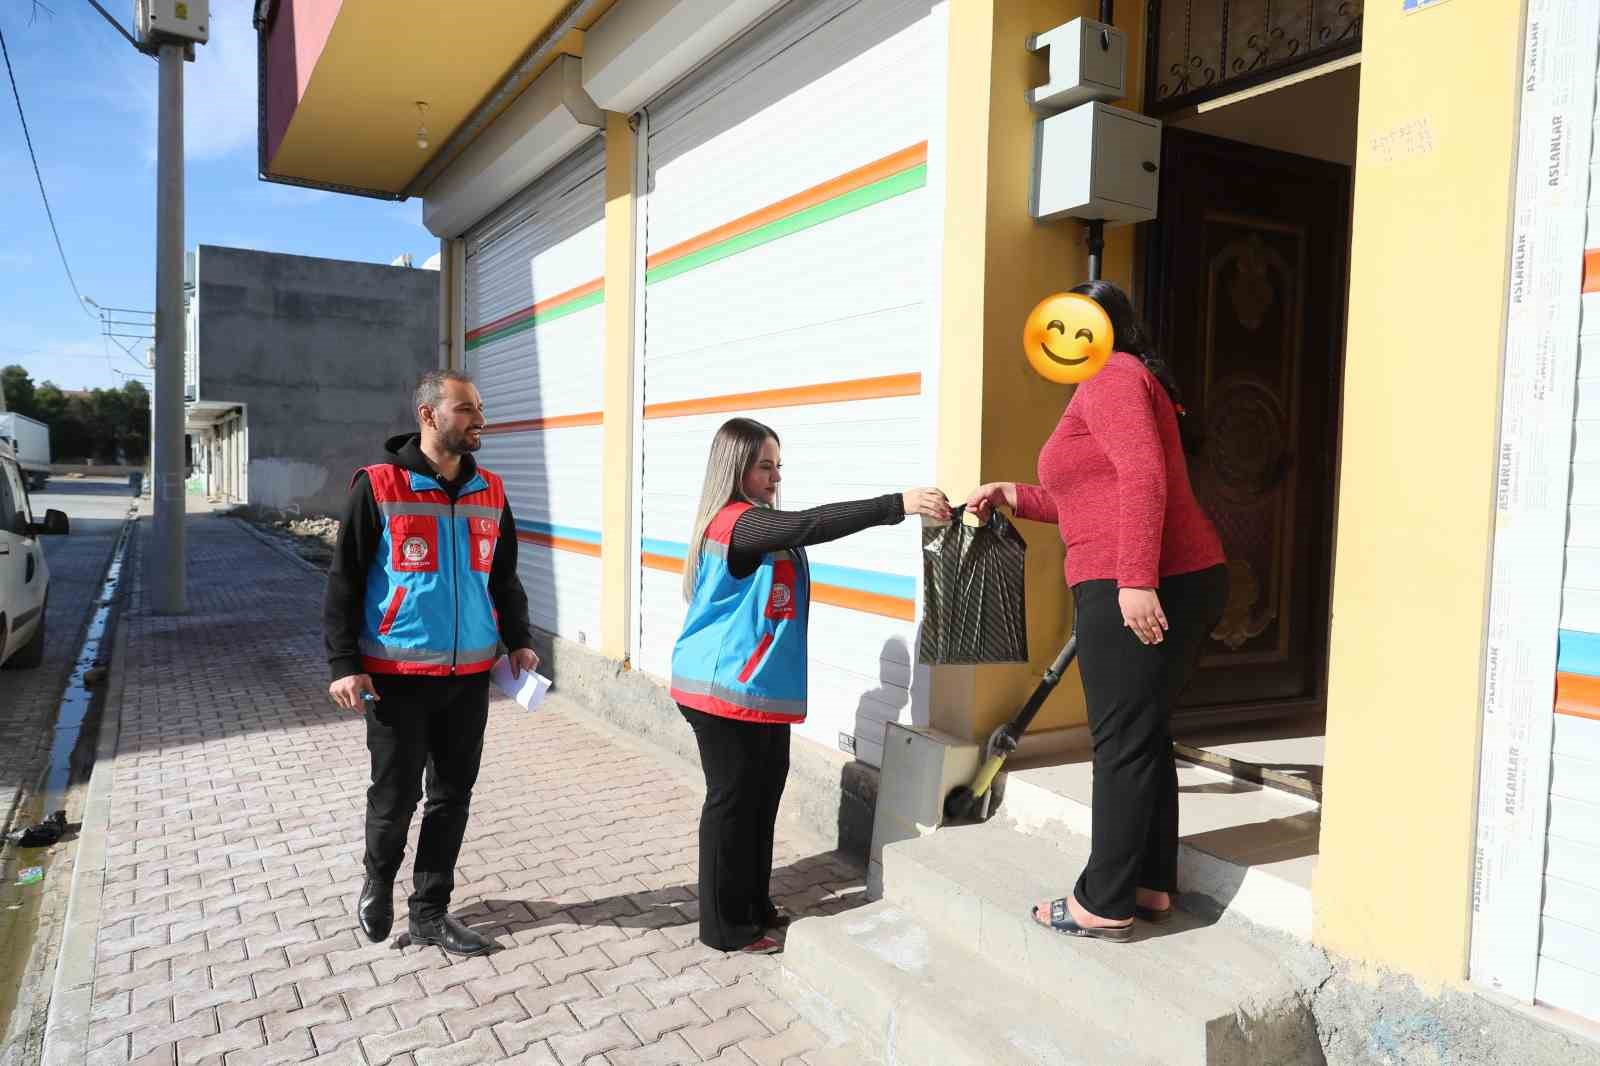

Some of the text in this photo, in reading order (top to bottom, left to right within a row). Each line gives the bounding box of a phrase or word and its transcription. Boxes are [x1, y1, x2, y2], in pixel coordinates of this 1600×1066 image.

[1548, 114, 1562, 187] ASLANLAR
[1513, 234, 1526, 304] ASLANLAR
[1505, 747, 1519, 815] ASLANLAR
